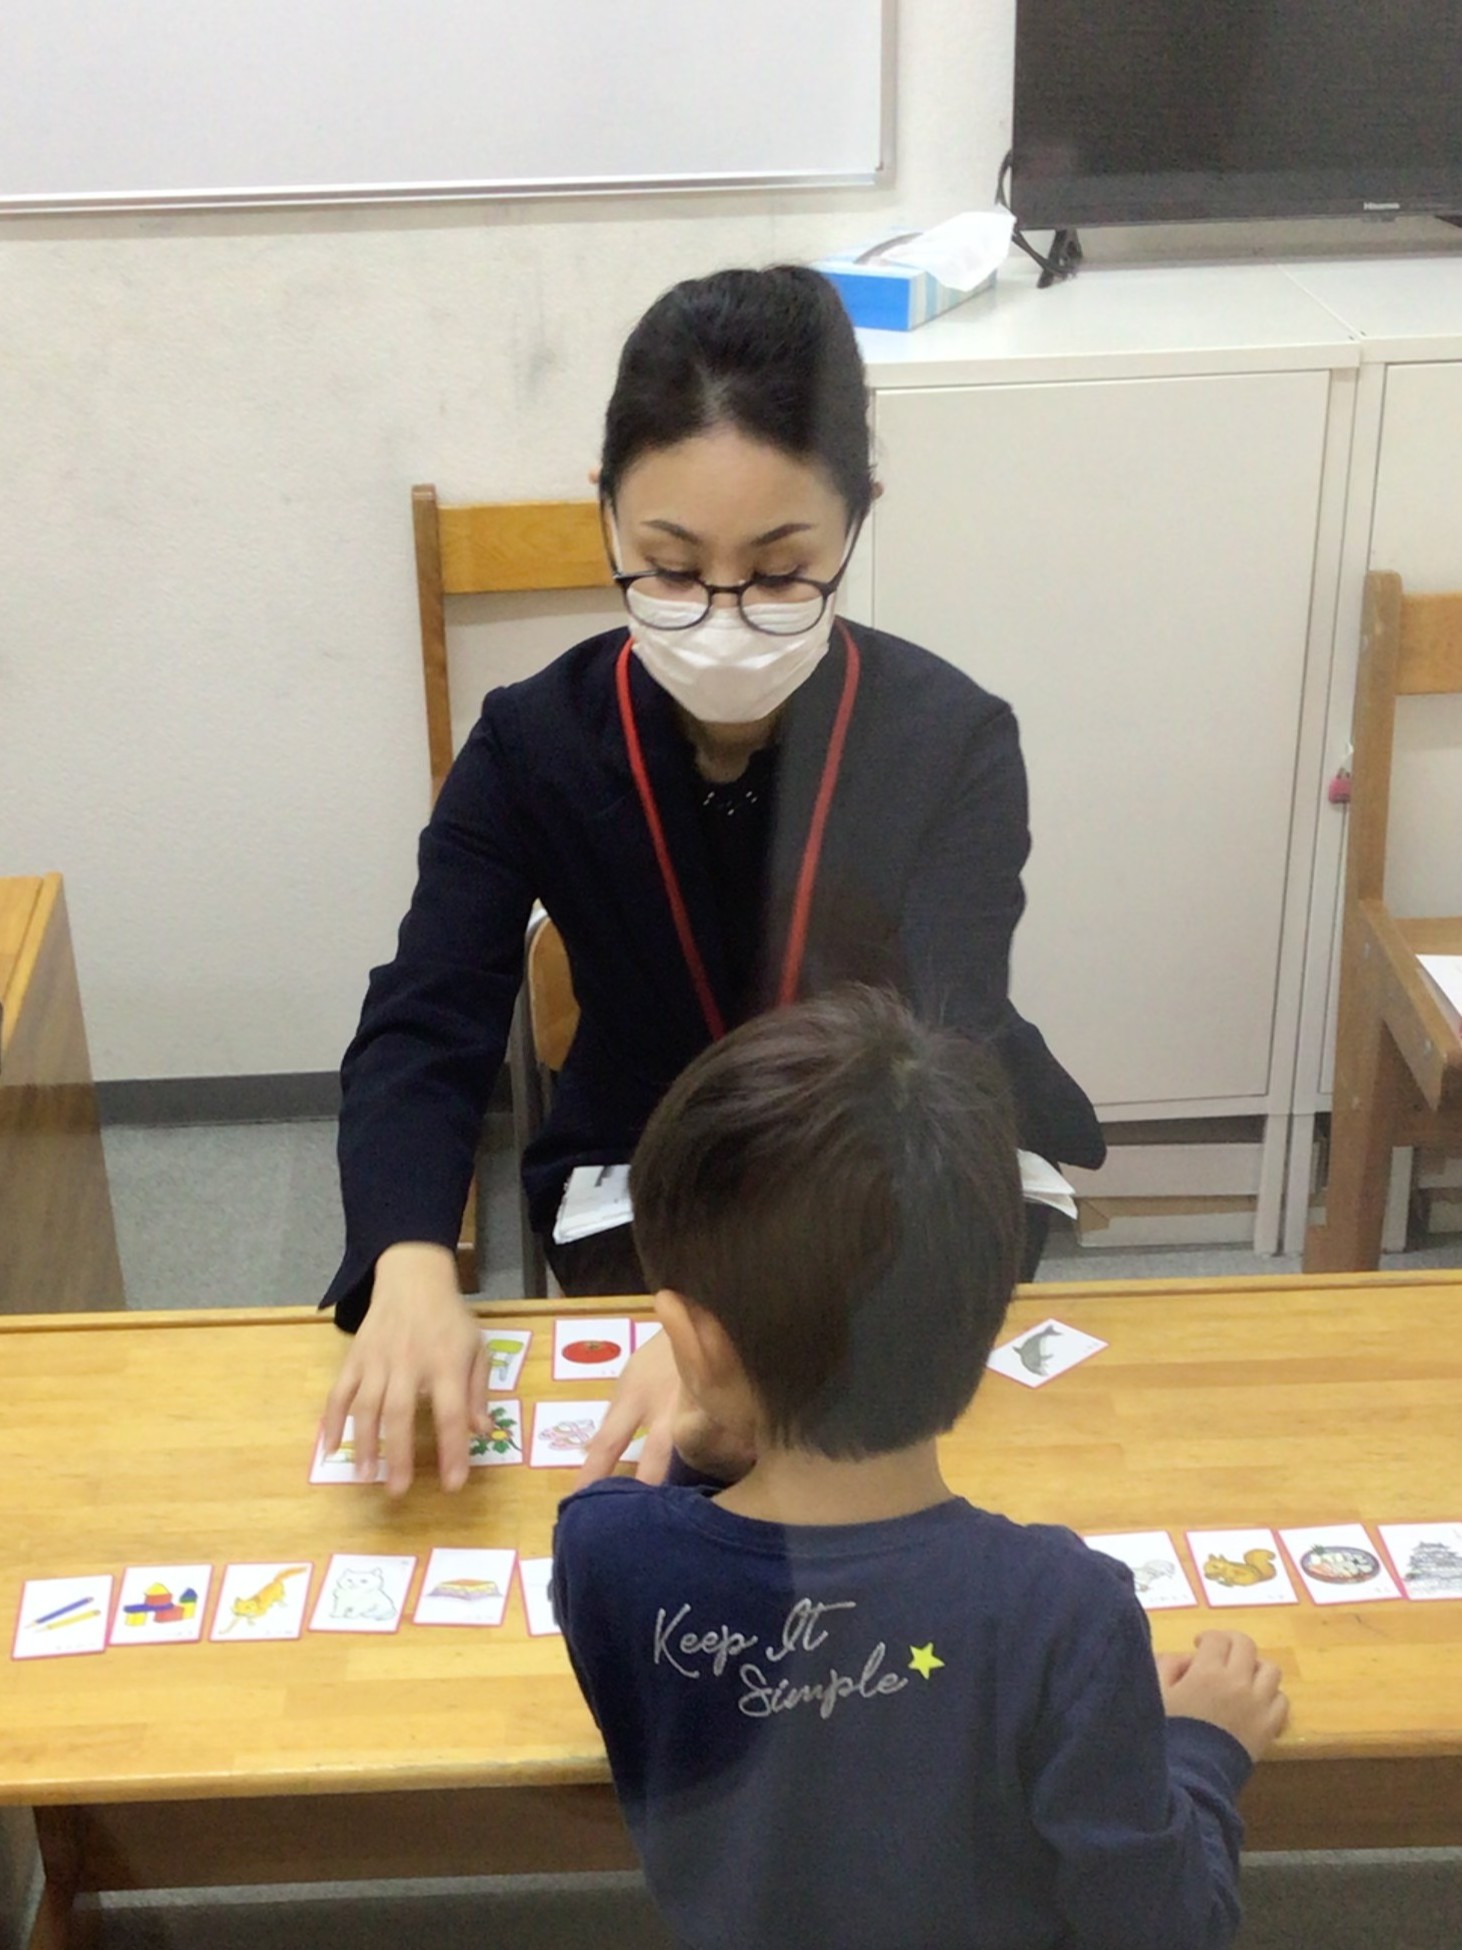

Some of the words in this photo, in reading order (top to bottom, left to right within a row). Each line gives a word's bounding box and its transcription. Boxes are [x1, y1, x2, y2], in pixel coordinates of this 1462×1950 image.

[654, 1604, 758, 1678] Keep
[766, 1598, 857, 1661] It
[739, 1642, 908, 1719] Simple
